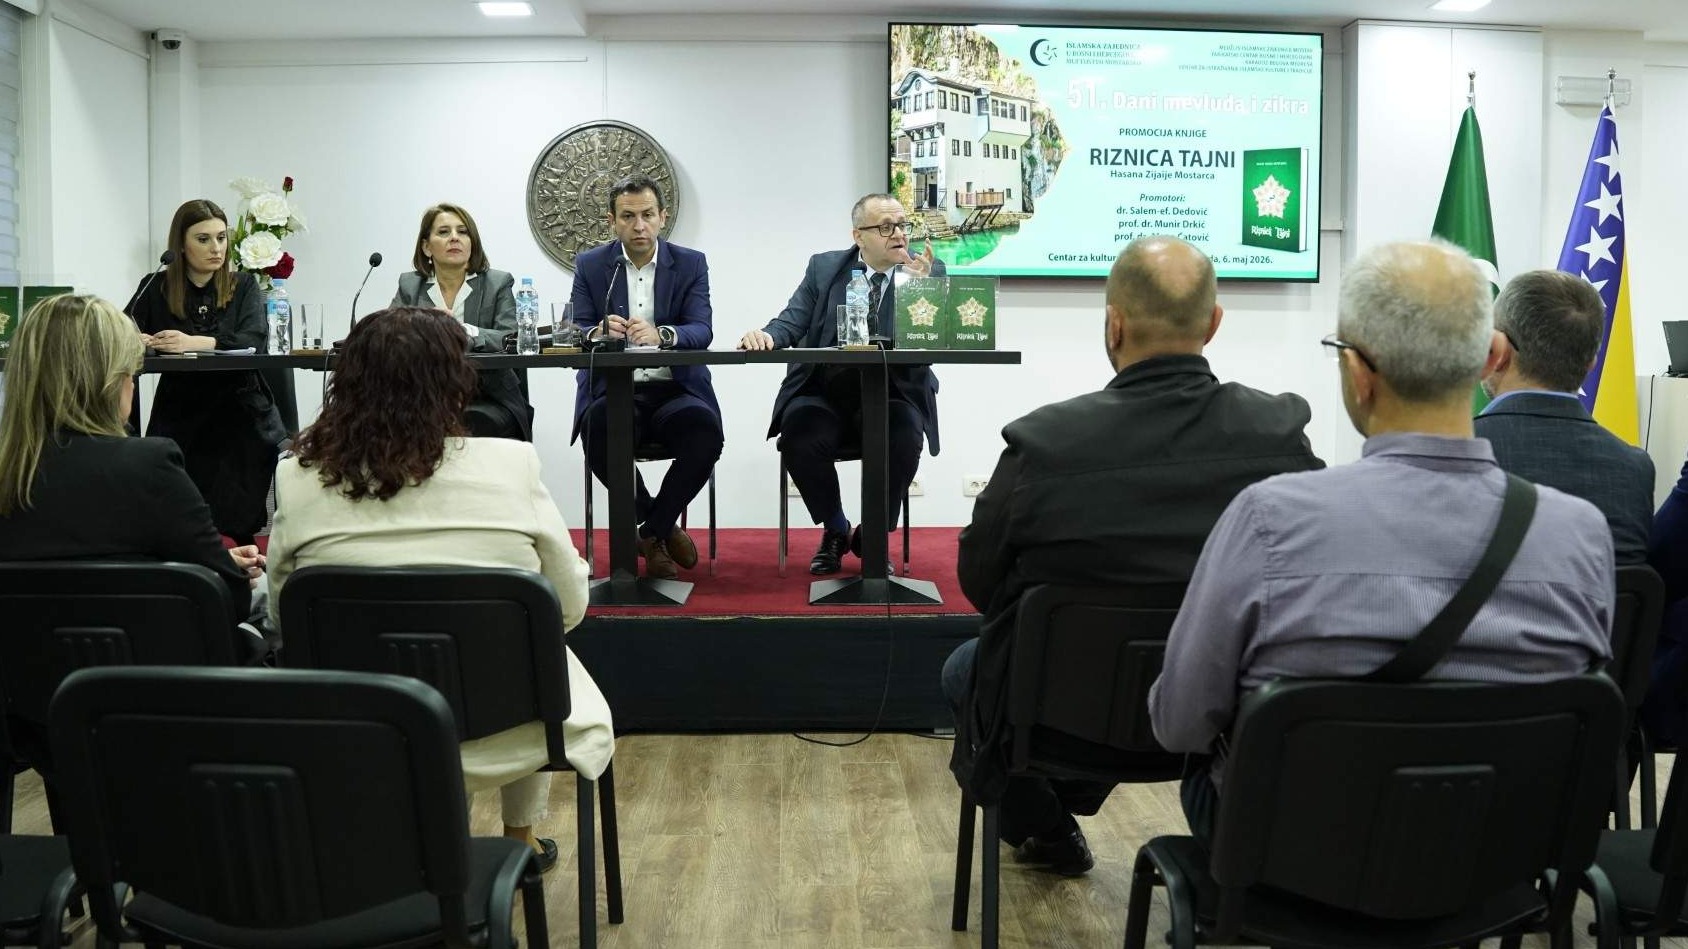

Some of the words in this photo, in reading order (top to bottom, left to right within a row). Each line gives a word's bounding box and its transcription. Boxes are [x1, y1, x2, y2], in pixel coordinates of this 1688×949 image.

[1067, 79, 1107, 110] 51.
[1113, 90, 1158, 111] Dani
[1163, 91, 1246, 114] mevluda
[1250, 93, 1258, 113] i
[1261, 94, 1309, 116] zikra
[1119, 128, 1173, 137] PROMOCIJA
[1175, 129, 1207, 138] KNJIGE
[1090, 148, 1174, 167] RIZNICA
[1179, 150, 1236, 168] TAJNI
[1110, 170, 1143, 178] Hasana
[1174, 171, 1215, 180] Mostarca
[1140, 193, 1186, 202] Promotori:
[1116, 206, 1128, 215] dr.
[1130, 206, 1171, 215] Salem-ef.
[1172, 207, 1208, 216] Dedović
[1118, 219, 1139, 229] prof.
[1141, 220, 1153, 228] dr.
[1155, 220, 1181, 228] Munir
[1182, 220, 1205, 229] Drkić
[1048, 253, 1077, 262] Centar
[1090, 253, 1117, 262] kultur
[1222, 255, 1231, 264] 6.
[1233, 255, 1248, 266] maj
[1250, 255, 1273, 264] 2026.
